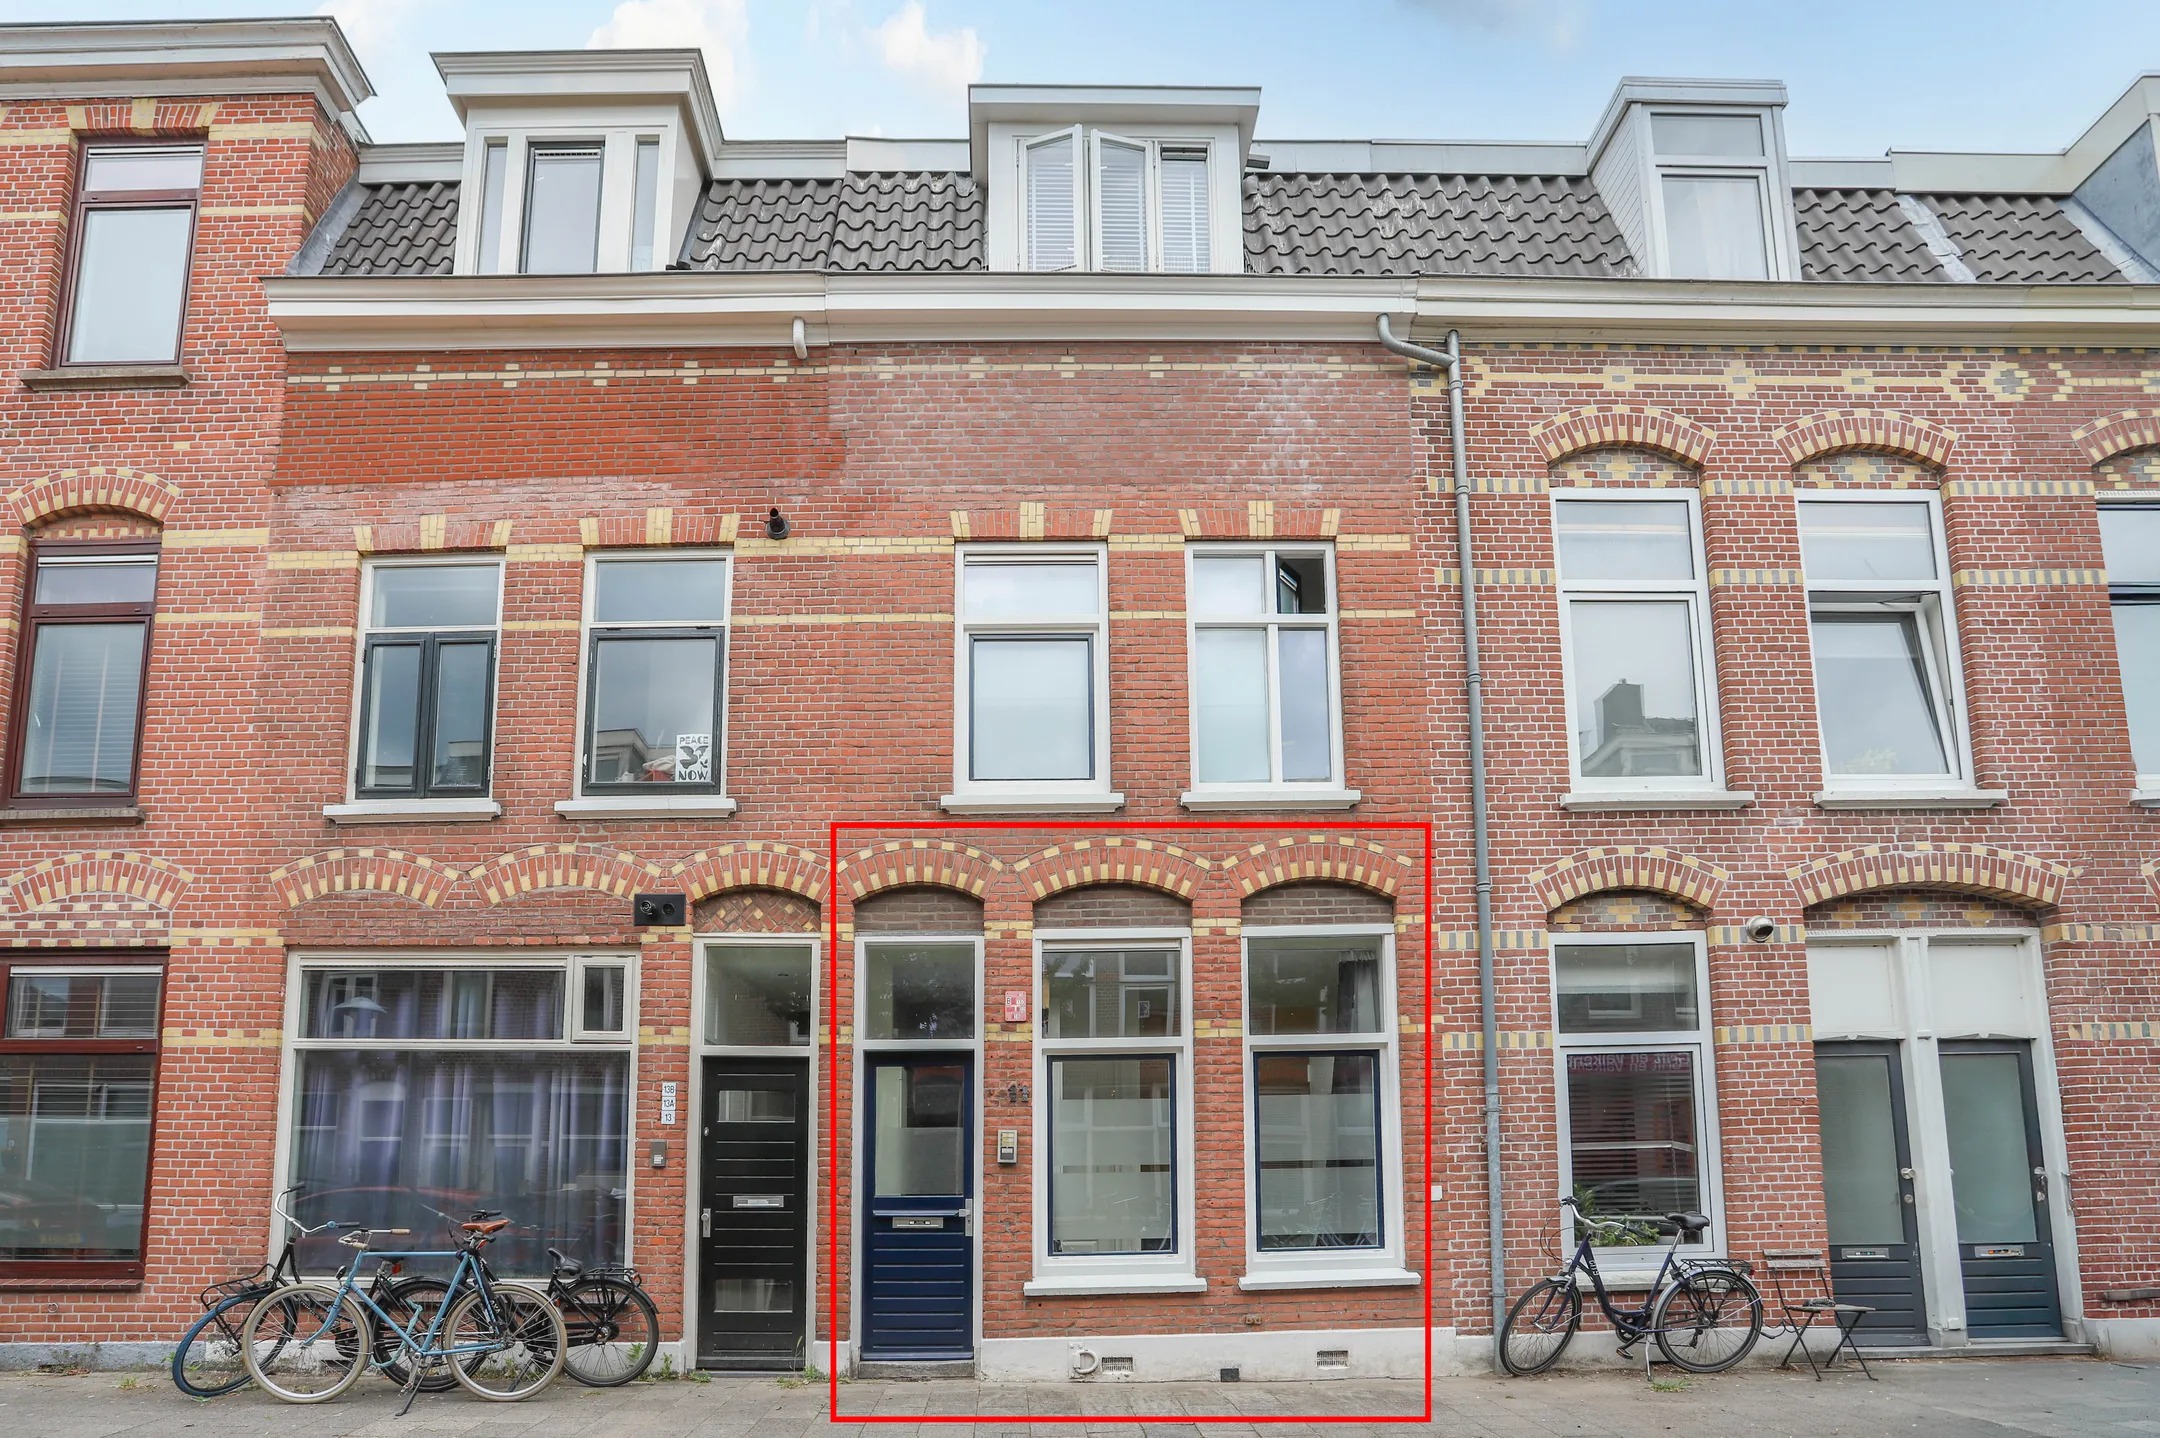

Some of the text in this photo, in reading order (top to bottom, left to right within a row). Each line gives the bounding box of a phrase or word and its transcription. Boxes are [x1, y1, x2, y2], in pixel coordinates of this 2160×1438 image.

[679, 736, 709, 745] PEACE
[678, 769, 709, 781] NOW
[663, 1085, 675, 1094] 13B
[663, 1099, 675, 1108] 13A
[665, 1113, 672, 1122] 13
